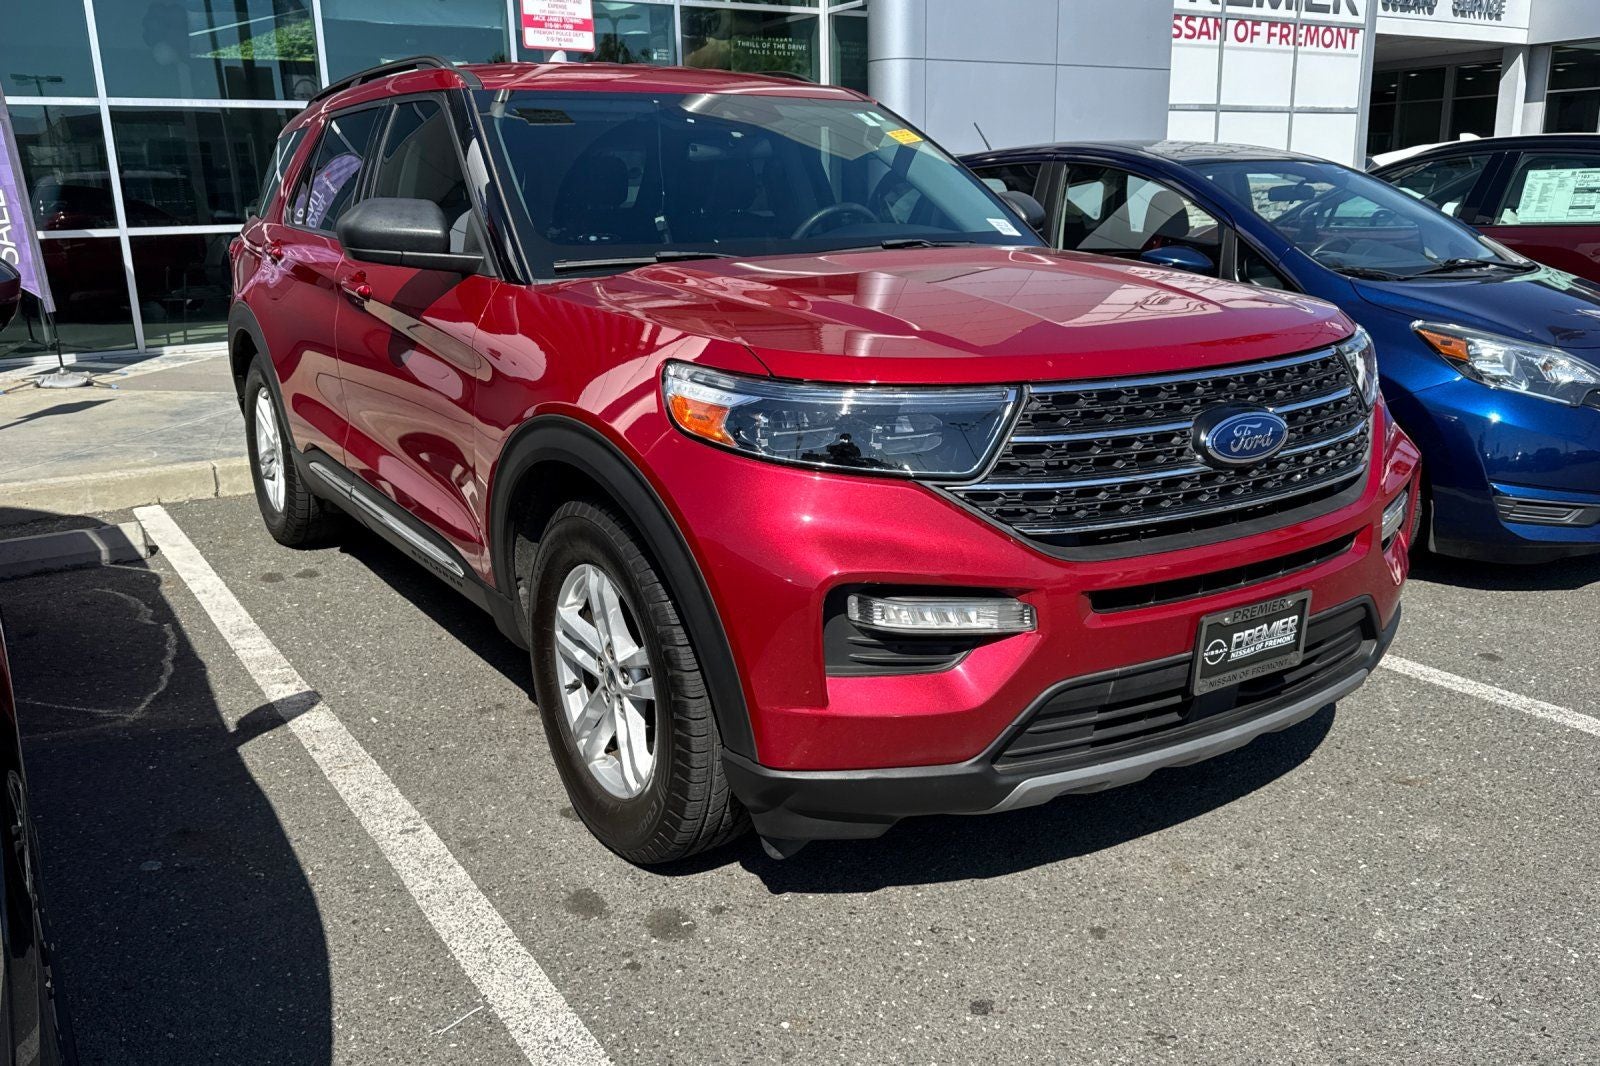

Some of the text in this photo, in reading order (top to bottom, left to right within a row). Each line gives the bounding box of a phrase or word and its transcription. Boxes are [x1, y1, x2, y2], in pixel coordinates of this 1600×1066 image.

[737, 40, 760, 48] THRILL
[787, 43, 807, 51] DRIVE
[1234, 19, 1262, 43] OF
[1267, 22, 1360, 50] FREMONT
[1230, 422, 1273, 453] Ford
[1232, 599, 1287, 622] PREMIER
[1230, 615, 1299, 652] PREMIER
[1230, 633, 1295, 659] NISSAN OF FREMONT
[1203, 647, 1228, 657] NISSAN
[1208, 659, 1289, 689] NISSAN OF FREMONT
